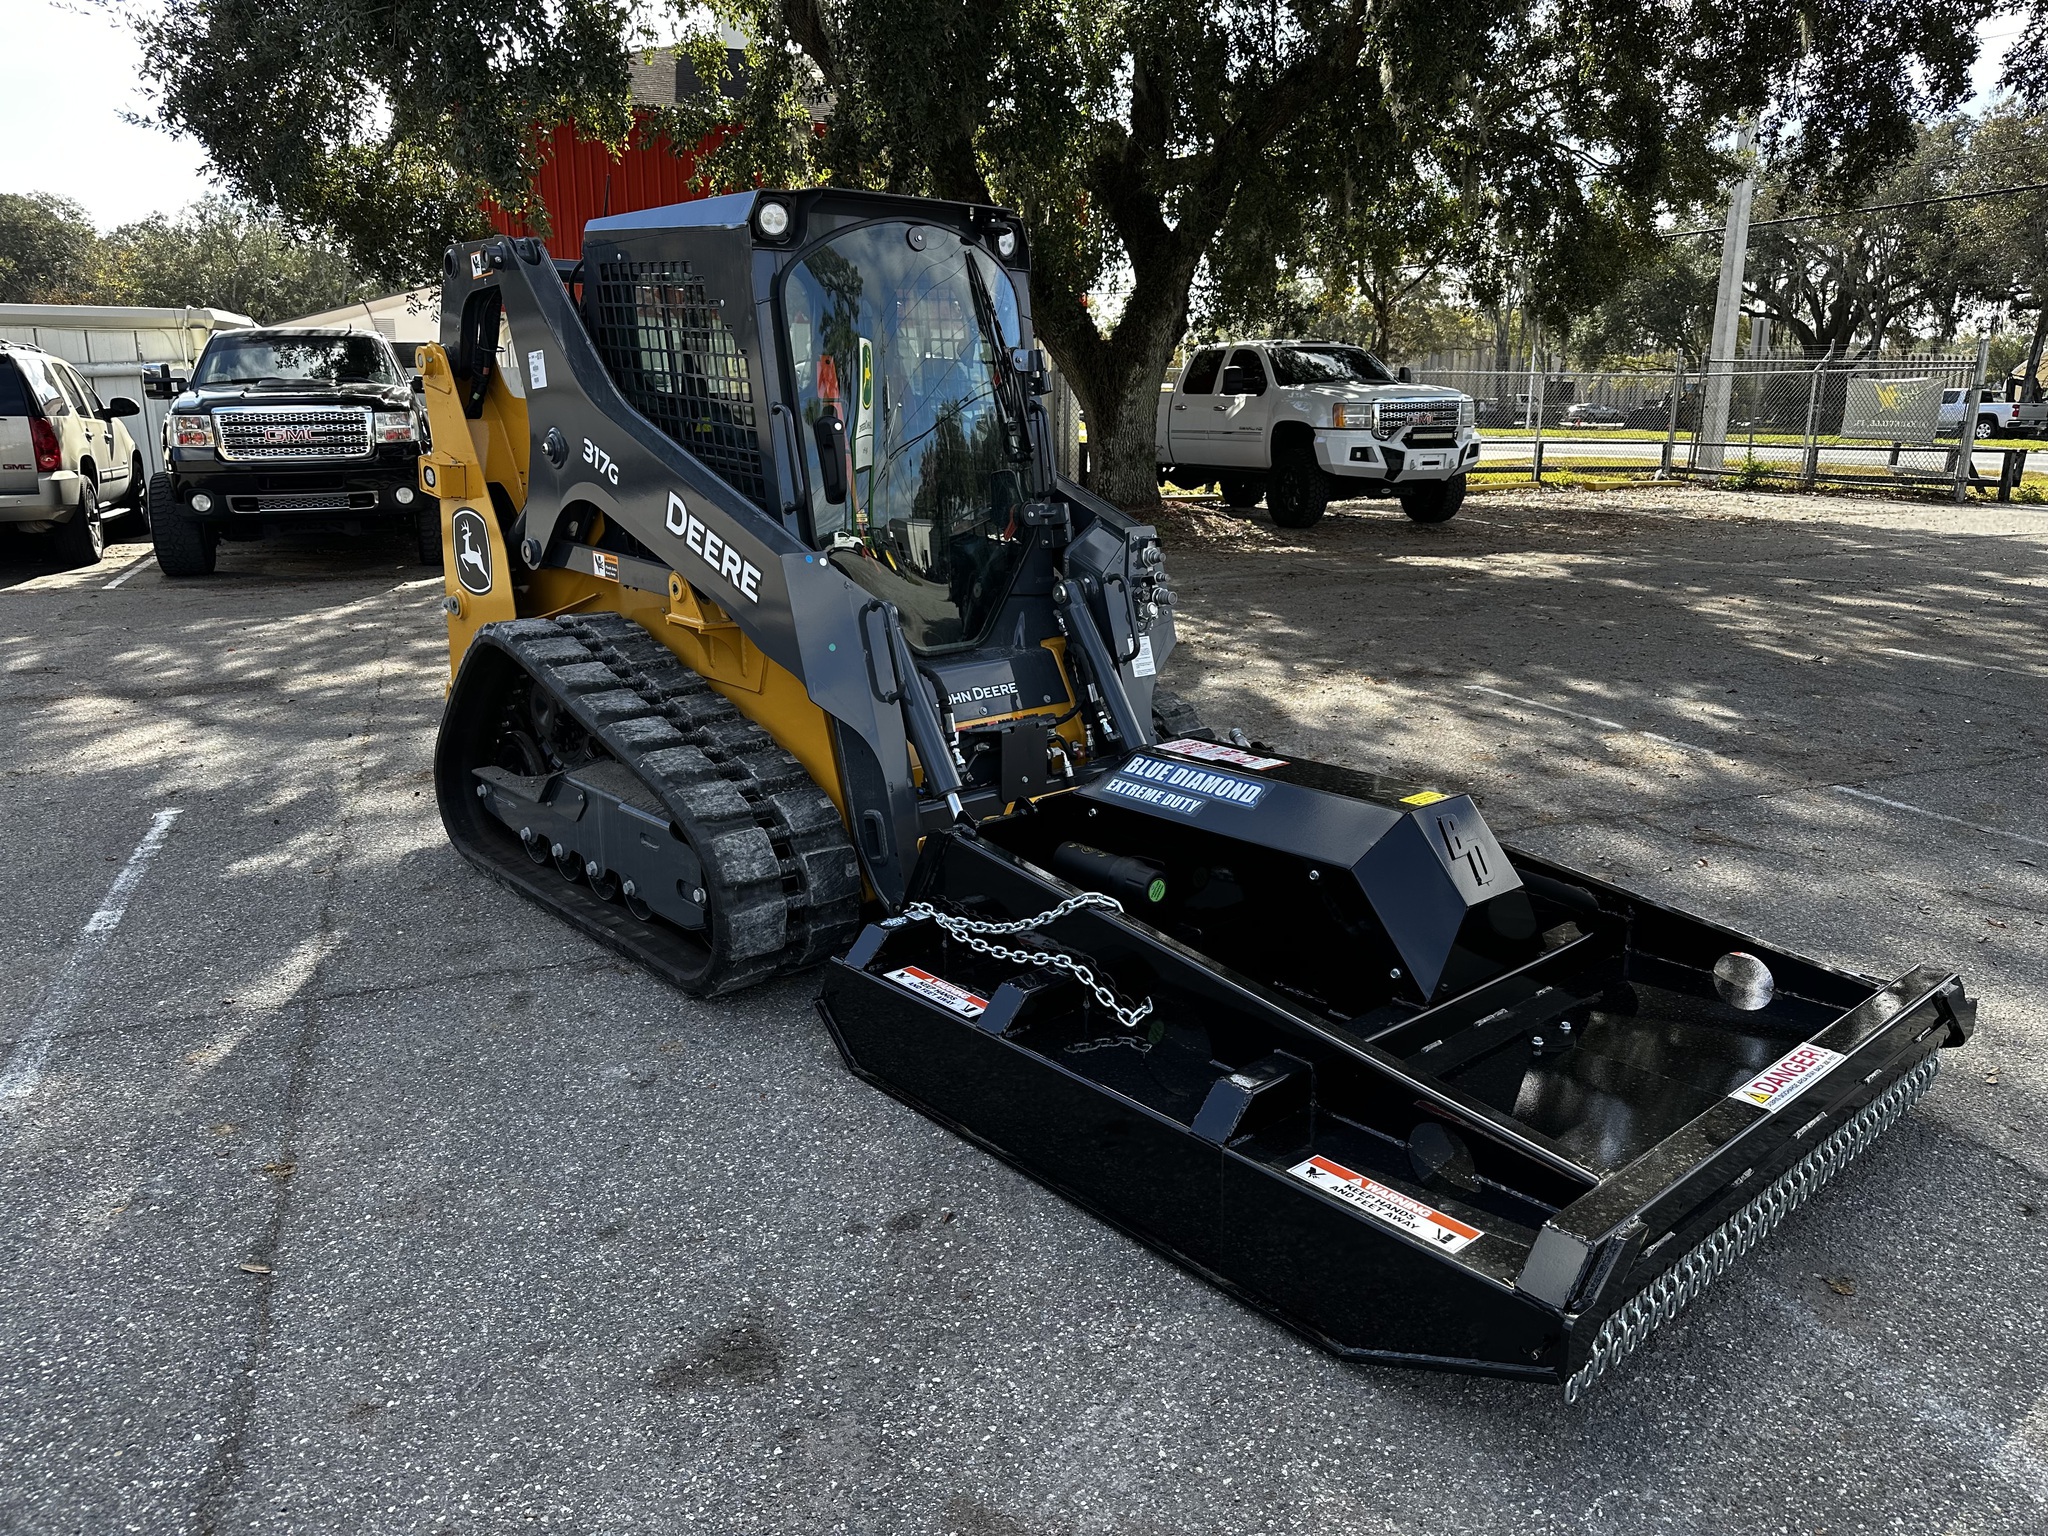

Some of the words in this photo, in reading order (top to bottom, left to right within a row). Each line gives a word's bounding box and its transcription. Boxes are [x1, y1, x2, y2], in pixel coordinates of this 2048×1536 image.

[265, 428, 326, 441] GMC
[1406, 415, 1437, 425] GMC
[582, 437, 619, 485] 317G
[666, 490, 761, 603] DEERE
[971, 682, 1018, 700] DEERE
[1105, 779, 1166, 803] EXTREME
[1160, 793, 1202, 813] DUTY
[1123, 757, 1174, 781] BLUE
[1167, 767, 1262, 803] DIAMOND
[1751, 1046, 1829, 1094] DANGER!
[1329, 1185, 1354, 1199] AND
[1354, 1197, 1389, 1213] FEET
[1385, 1212, 1420, 1230] AWAY
[1343, 1184, 1375, 1201] KEEP
[1376, 1199, 1416, 1221] HANDS
[1364, 1183, 1433, 1218] WARNING
